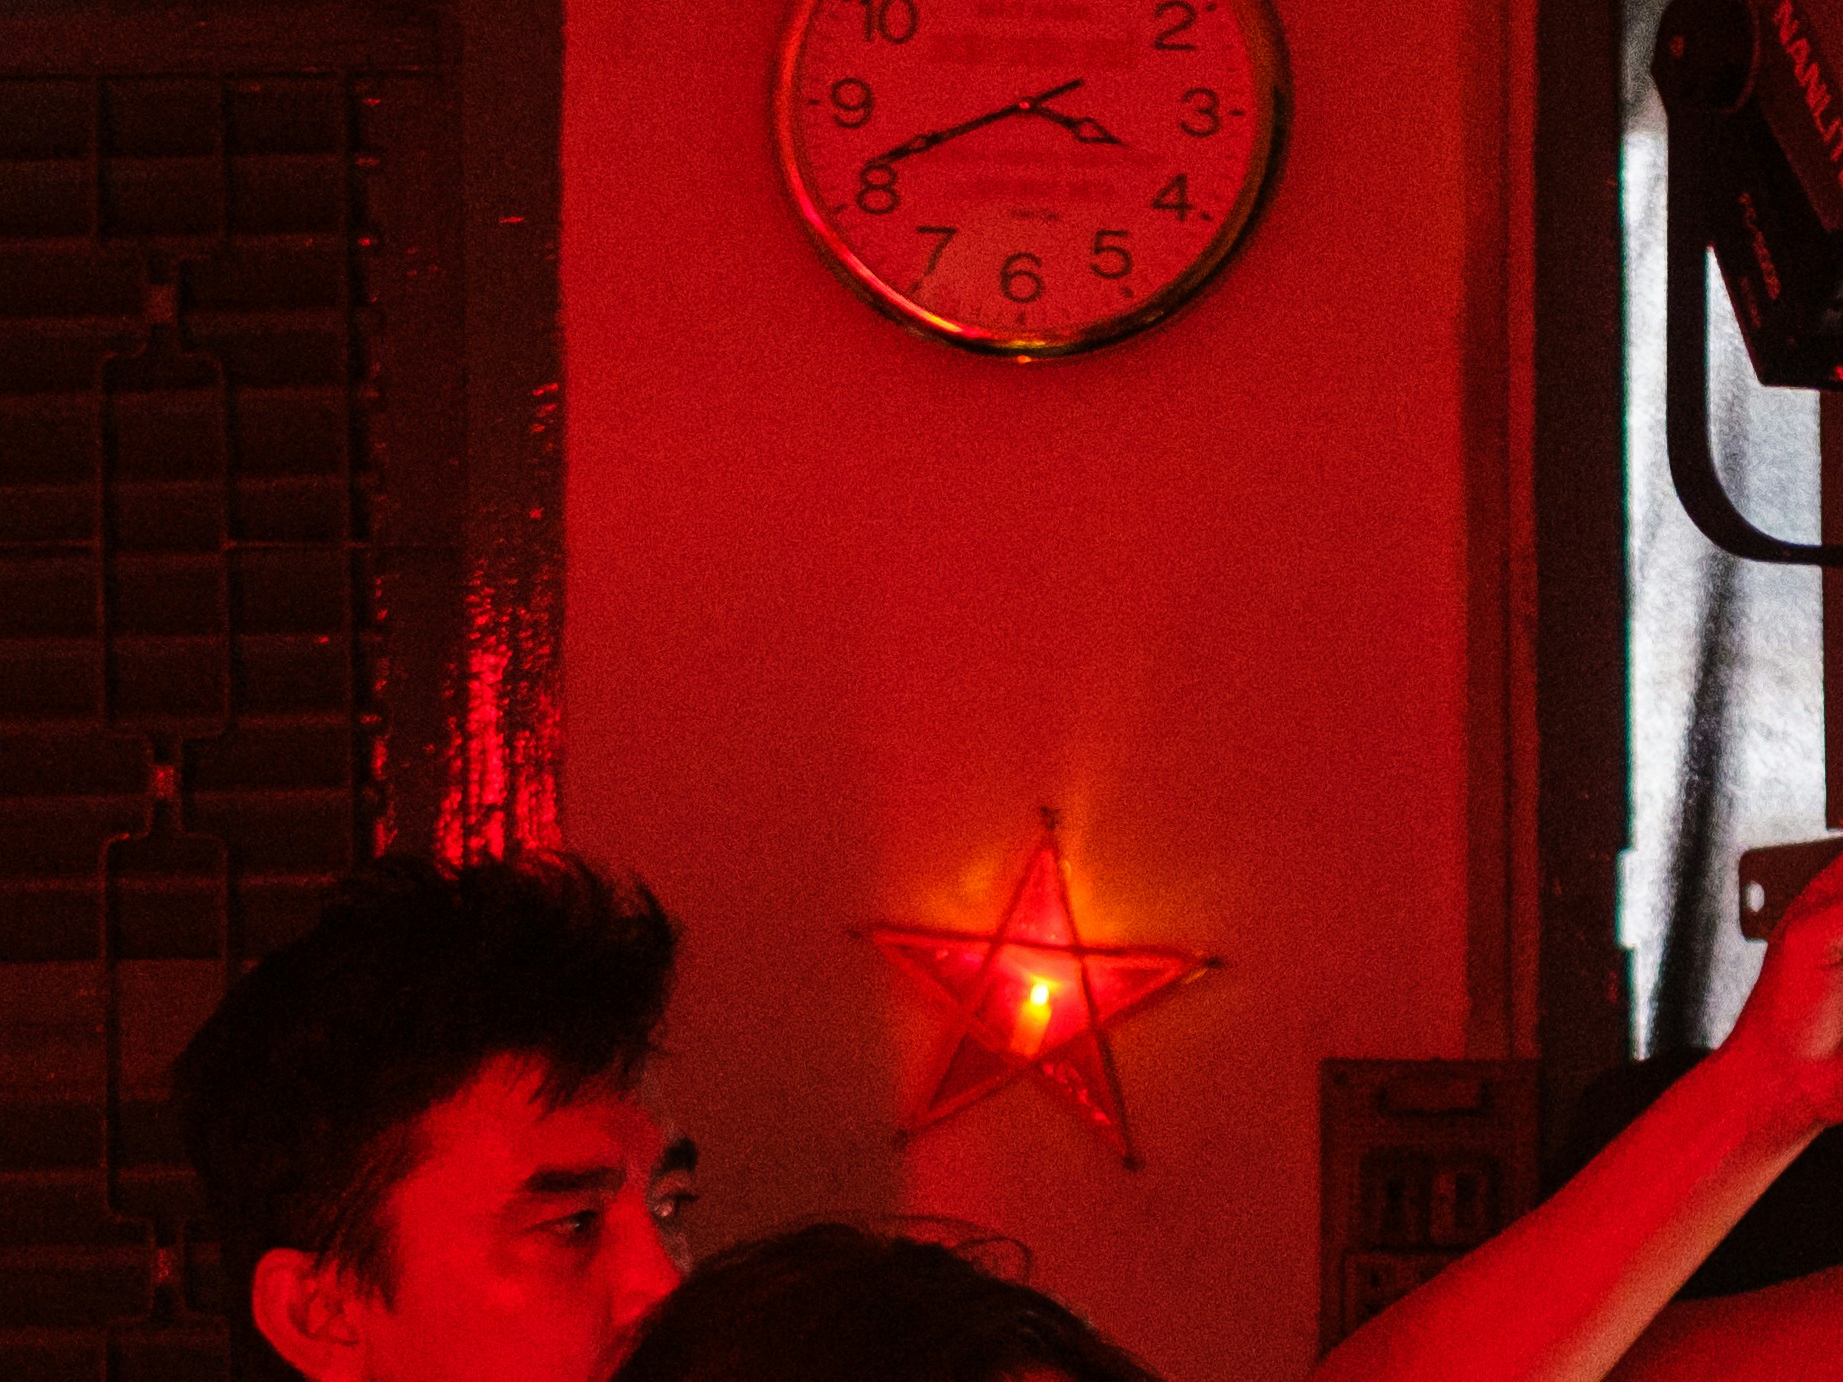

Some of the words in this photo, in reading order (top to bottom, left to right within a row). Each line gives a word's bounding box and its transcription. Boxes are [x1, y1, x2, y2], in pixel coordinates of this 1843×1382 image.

[857, 0, 919, 44] 10
[1152, 0, 1199, 51] 2
[829, 77, 876, 130] 9
[1178, 87, 1223, 138] 3
[855, 162, 902, 215] 8
[1150, 173, 1194, 222] 4
[915, 225, 958, 277] 7
[1090, 230, 1135, 280] 5
[998, 252, 1046, 304] 6
